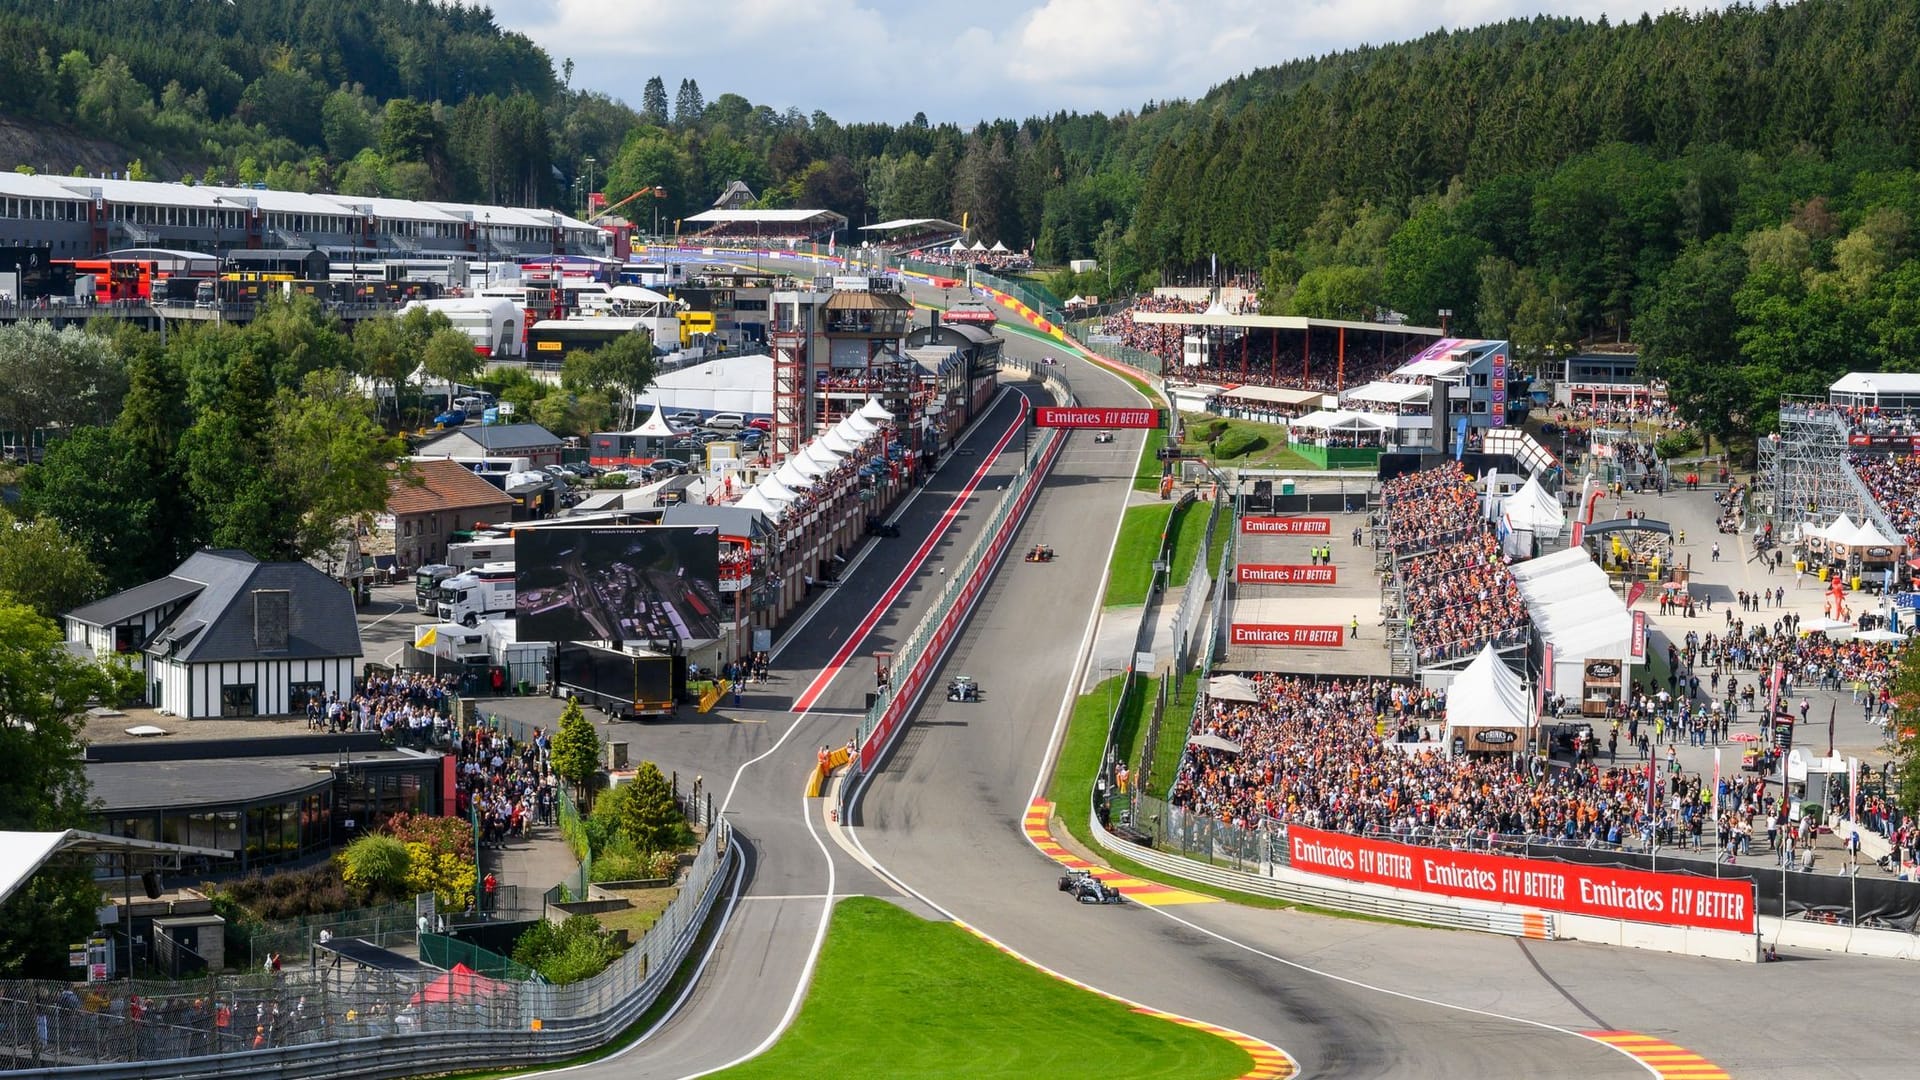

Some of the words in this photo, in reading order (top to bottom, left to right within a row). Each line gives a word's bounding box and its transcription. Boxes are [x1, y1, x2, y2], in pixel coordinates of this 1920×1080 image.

[1046, 411, 1100, 424] Emirates
[1105, 412, 1118, 424] FLY
[1120, 412, 1149, 424] BETTER
[1246, 521, 1288, 531] Emirates
[1291, 522, 1302, 531] FLY
[1303, 522, 1327, 532] BETTER
[1242, 568, 1289, 580] Emirates
[1293, 569, 1305, 580] FLY
[1306, 570, 1332, 580] BETTER
[1236, 628, 1290, 641] Emirates
[1294, 630, 1308, 642] FLY
[1309, 630, 1338, 642] BETTER
[1293, 837, 1355, 869] Emirates
[1359, 849, 1375, 873] FLY
[1377, 852, 1413, 880] BETTER
[1423, 860, 1497, 891] Emirates
[1502, 868, 1520, 895] FLY
[1524, 873, 1565, 900] BETTER
[1579, 878, 1664, 911] Emirates
[1671, 887, 1693, 915] FLY
[1696, 890, 1744, 921] BETTER
